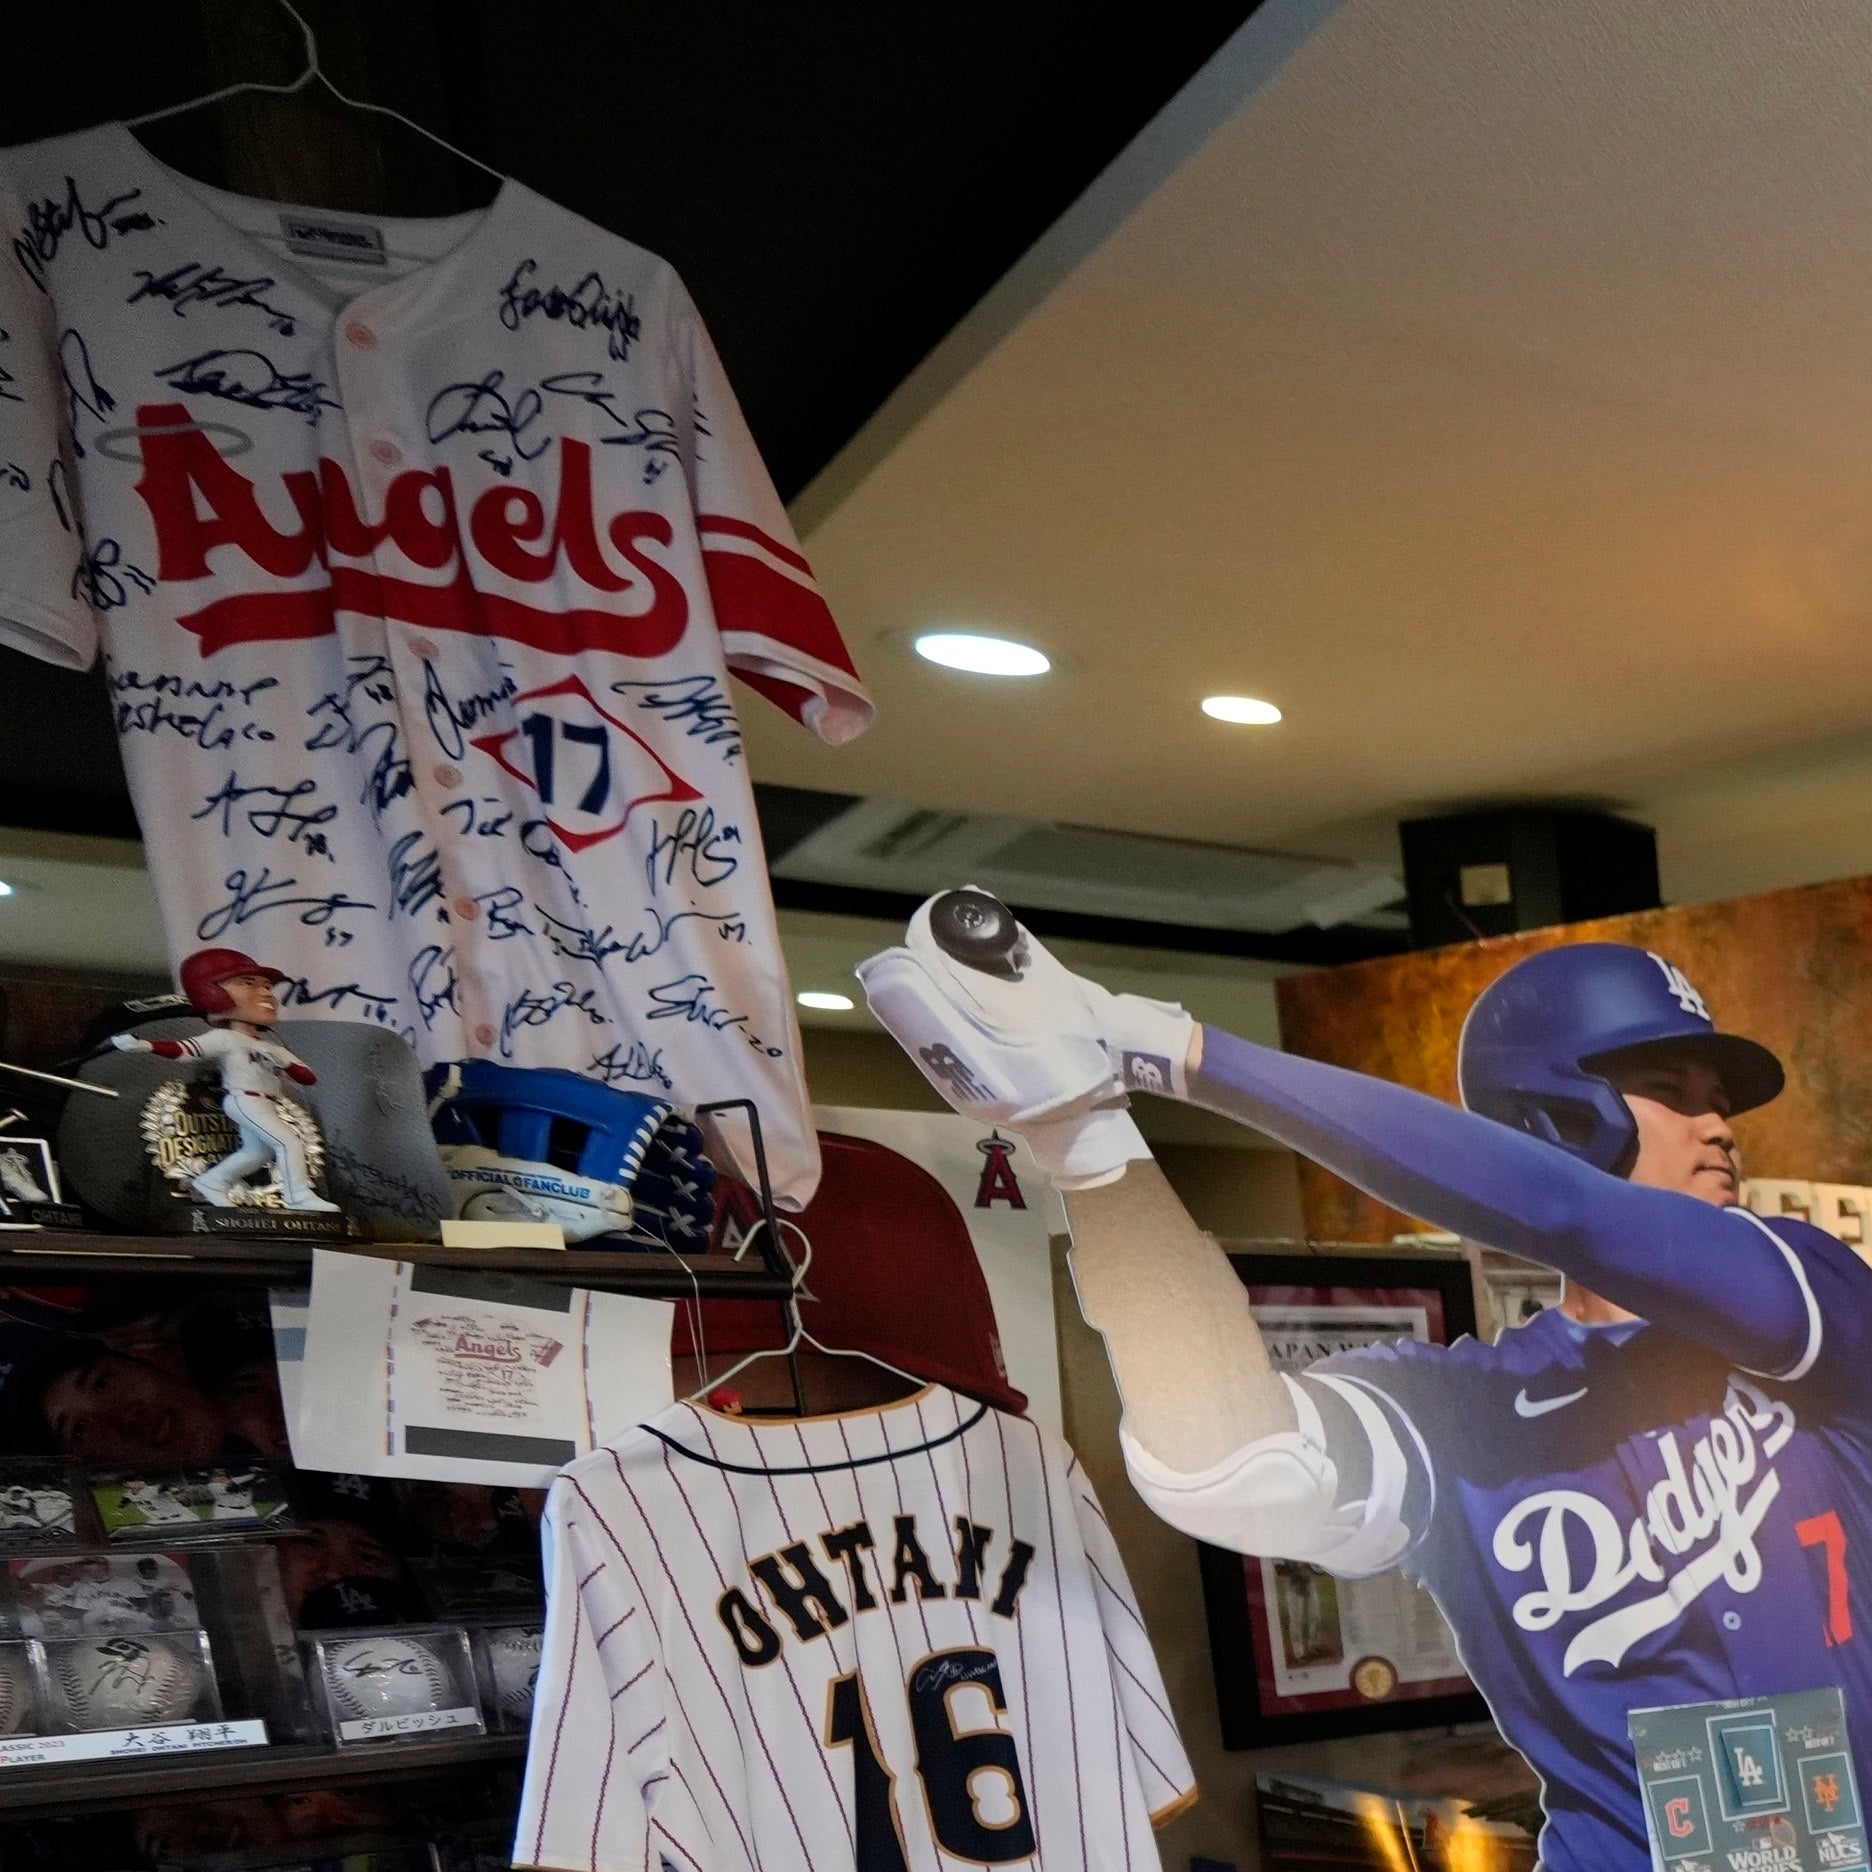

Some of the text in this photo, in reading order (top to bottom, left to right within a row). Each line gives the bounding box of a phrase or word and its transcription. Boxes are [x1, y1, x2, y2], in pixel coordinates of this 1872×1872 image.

[134, 402, 688, 658] Angels
[522, 712, 610, 816] 17
[1647, 950, 1712, 1021] LA
[521, 1176, 591, 1201] FANCLUB
[453, 1335, 523, 1364] Angels
[1493, 1381, 1797, 1678] Dodgers
[717, 1514, 1037, 1668] OHTANI
[122, 1723, 236, 1749] 大谷 翔平
[359, 1715, 460, 1735] ダルビッシュ
[1733, 1747, 1766, 1787] LA
[1665, 1797, 1695, 1839] C
[1726, 1846, 1798, 1870] WORLD
[1817, 1841, 1863, 1865] NLCS
